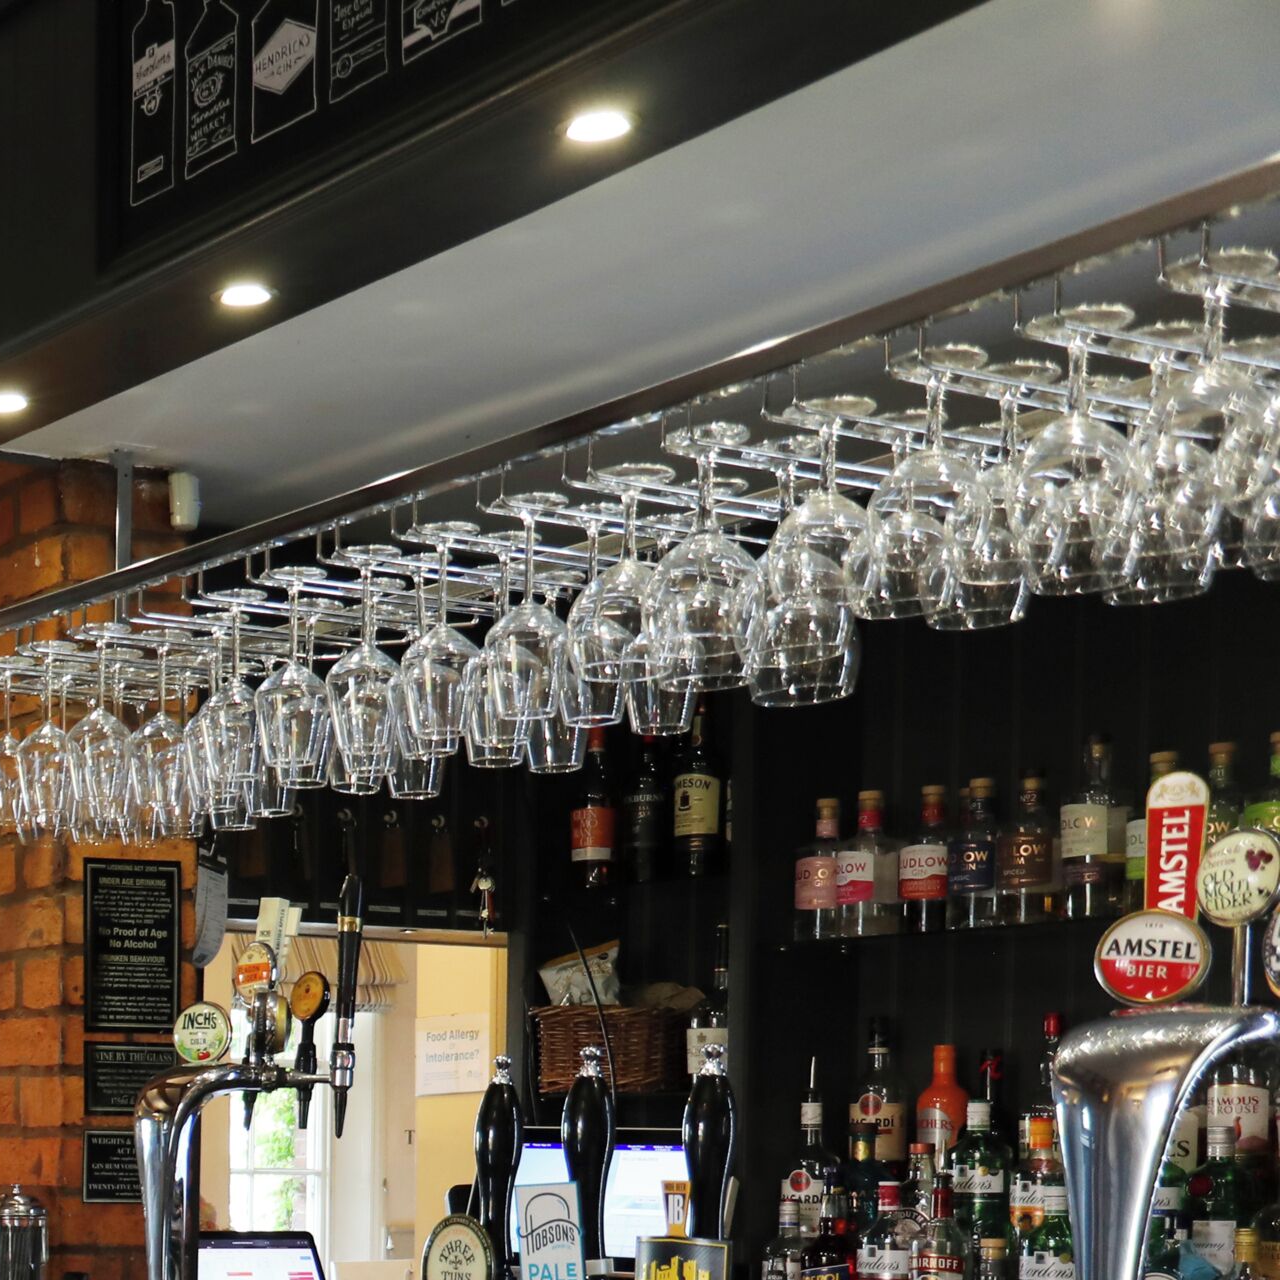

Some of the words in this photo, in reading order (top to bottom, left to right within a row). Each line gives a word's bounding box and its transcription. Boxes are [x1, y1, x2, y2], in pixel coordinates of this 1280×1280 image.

[899, 855, 948, 869] LUDLOW
[1157, 809, 1190, 915] AMSTEL
[99, 877, 120, 886] UNDER
[122, 878, 134, 886] AGE
[135, 878, 167, 887] DRINKING
[1203, 868, 1234, 887] OLD
[1205, 891, 1253, 913] CIDER
[113, 927, 138, 937] Proof
[139, 927, 149, 937] of
[150, 928, 168, 939] Age
[109, 939, 121, 948] No
[124, 939, 157, 949] Alcohol
[1105, 938, 1197, 961] AMSTEL
[129, 955, 166, 963] BEHAVIOUR
[1126, 963, 1168, 979] BIER
[426, 1031, 447, 1042] Food
[448, 1028, 480, 1042] Allergy
[116, 1052, 127, 1062] BY
[128, 1052, 146, 1062] THE
[147, 1053, 173, 1063] GLASS
[425, 1049, 480, 1063] Intolerance?
[91, 1137, 125, 1145] WEIGHTS
[117, 1147, 131, 1155] ACT
[91, 1162, 104, 1170] GIN
[667, 1193, 684, 1225] IB
[525, 1213, 576, 1257] HOBSONS
[439, 1239, 476, 1266] THREE
